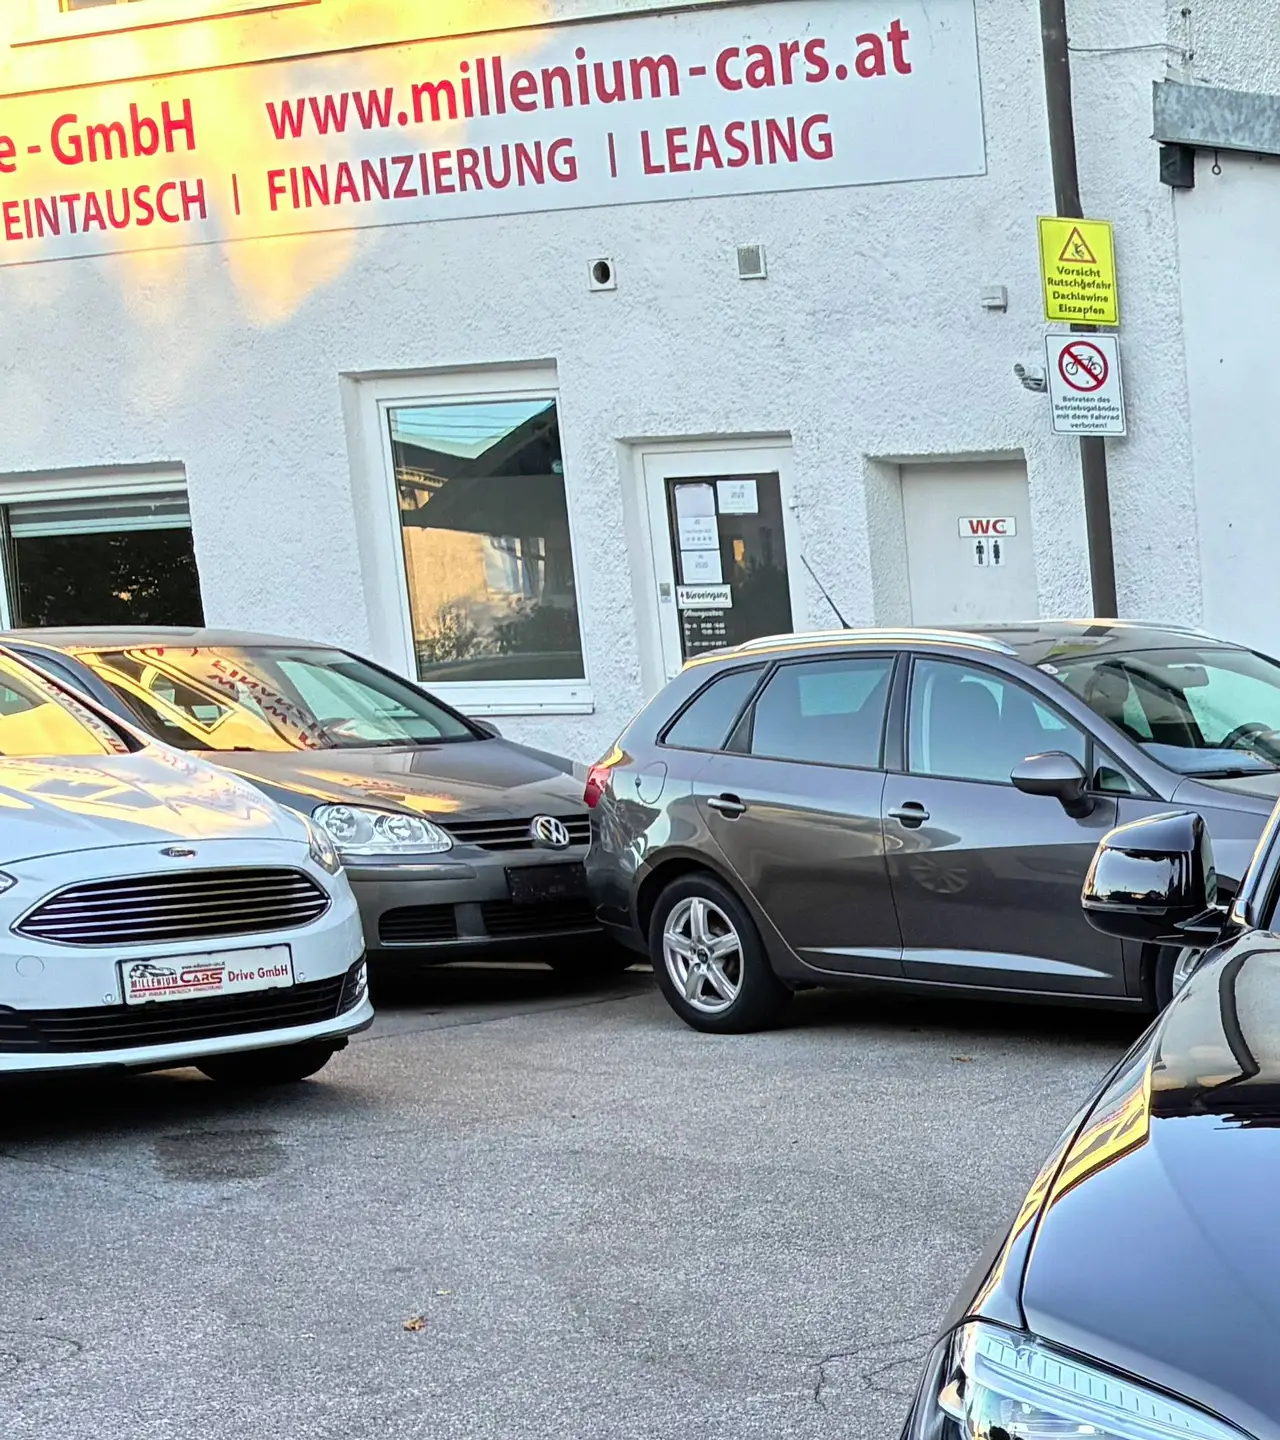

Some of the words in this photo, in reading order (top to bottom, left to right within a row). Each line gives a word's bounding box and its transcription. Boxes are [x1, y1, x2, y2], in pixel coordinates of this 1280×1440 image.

[265, 18, 913, 141] www.millenium-cars.at
[2, 178, 207, 241] EINTAUSCH
[267, 137, 579, 212] FINANZIERUNG
[640, 113, 835, 175] LEASING
[1056, 266, 1101, 278] Vorsicht
[1047, 277, 1112, 291] Rutschgefahr
[1053, 291, 1109, 303] Dachlawine
[1058, 303, 1105, 318] Eiszapfen
[968, 519, 1008, 535] WC
[130, 974, 178, 988] MILLENIUM
[180, 968, 223, 984] CARS
[227, 969, 255, 983] Drive
[257, 964, 289, 979] GmbH
